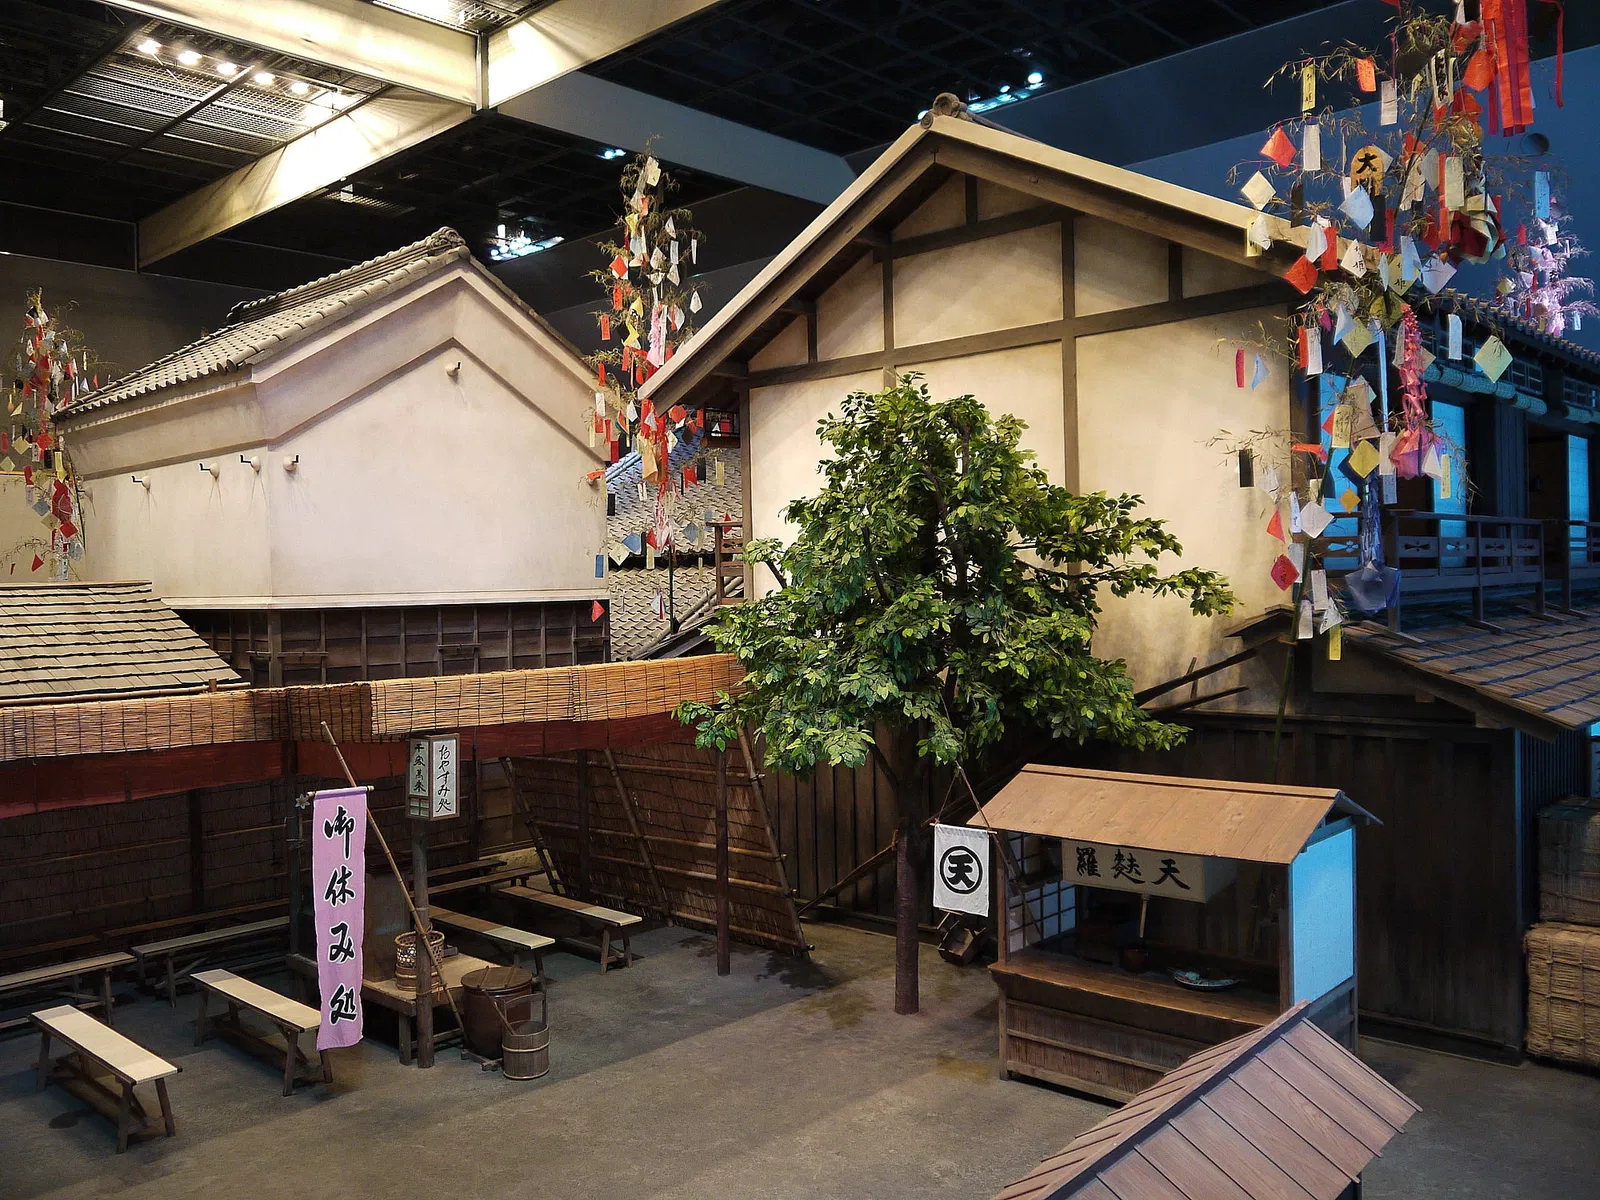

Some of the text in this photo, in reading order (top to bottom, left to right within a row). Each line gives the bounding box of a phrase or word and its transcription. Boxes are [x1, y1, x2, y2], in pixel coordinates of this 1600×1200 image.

[324, 806, 356, 1025] 御休み処
[947, 853, 976, 890] 天
